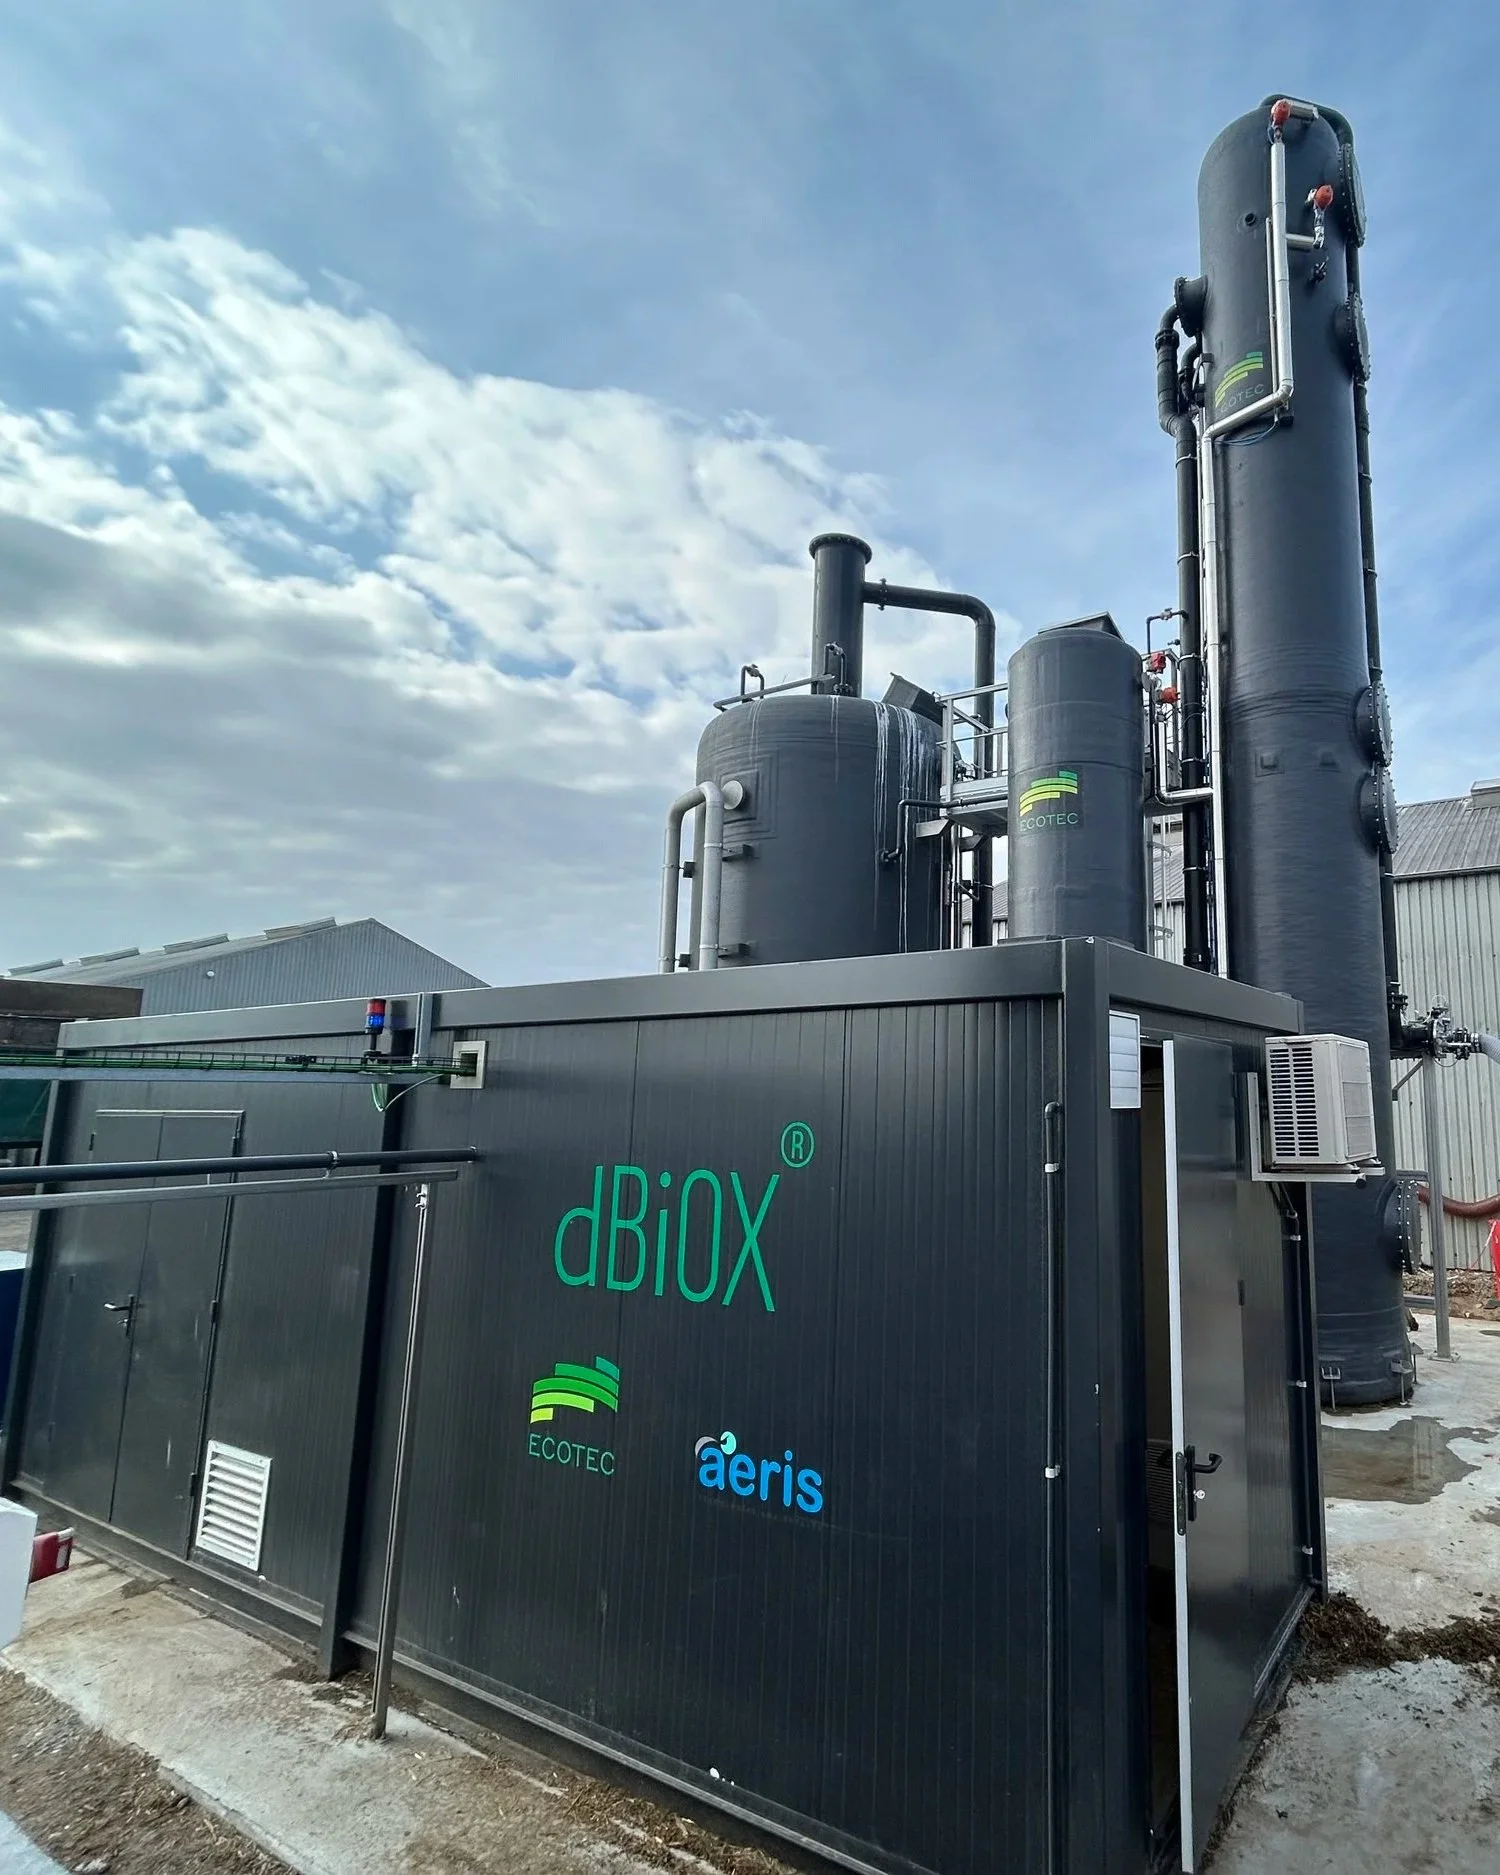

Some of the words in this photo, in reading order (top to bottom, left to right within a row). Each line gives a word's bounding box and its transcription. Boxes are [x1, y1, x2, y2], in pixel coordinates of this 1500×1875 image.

[1019, 812, 1079, 832] ECOTEC
[528, 1433, 615, 1476] ECOTEC
[699, 1447, 824, 1513] aeris
